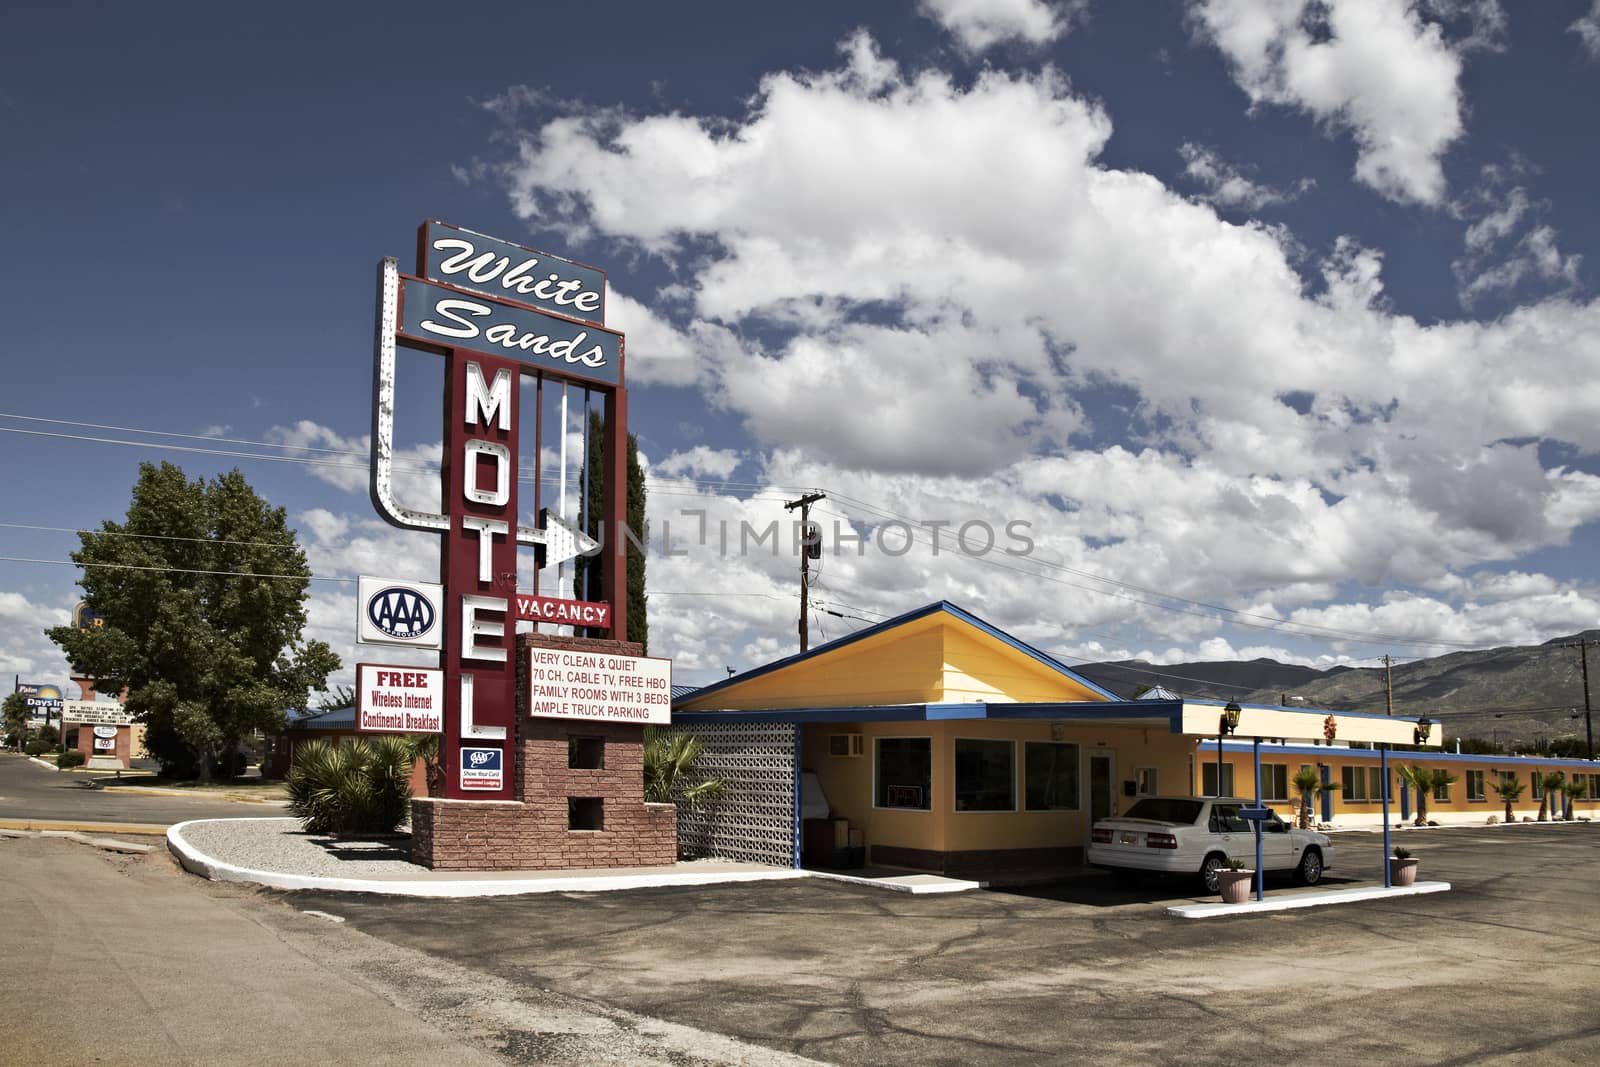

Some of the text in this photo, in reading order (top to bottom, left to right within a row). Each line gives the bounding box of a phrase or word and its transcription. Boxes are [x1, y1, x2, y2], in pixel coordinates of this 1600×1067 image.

[433, 238, 600, 312] White
[420, 299, 607, 368] Sands
[461, 360, 512, 740] MOTEL
[378, 589, 425, 633] AAA
[516, 598, 607, 623] VACANCY
[382, 626, 422, 638] APPROVED
[533, 652, 637, 672] VERY CLEAN & QUIET
[377, 671, 428, 688] FREE
[533, 668, 545, 681] 70
[547, 669, 563, 682] CH.
[567, 671, 600, 685] CABLE
[619, 675, 644, 688] FREE
[646, 678, 667, 689] HBO
[27, 698, 53, 707] Days
[372, 690, 432, 709] Wireless Internet
[533, 685, 669, 705] FAMILY ROOMS WITH 3 BEDS
[363, 710, 440, 730] Continental Breakfast
[534, 701, 650, 719] AMPLE TRUCK PARKING
